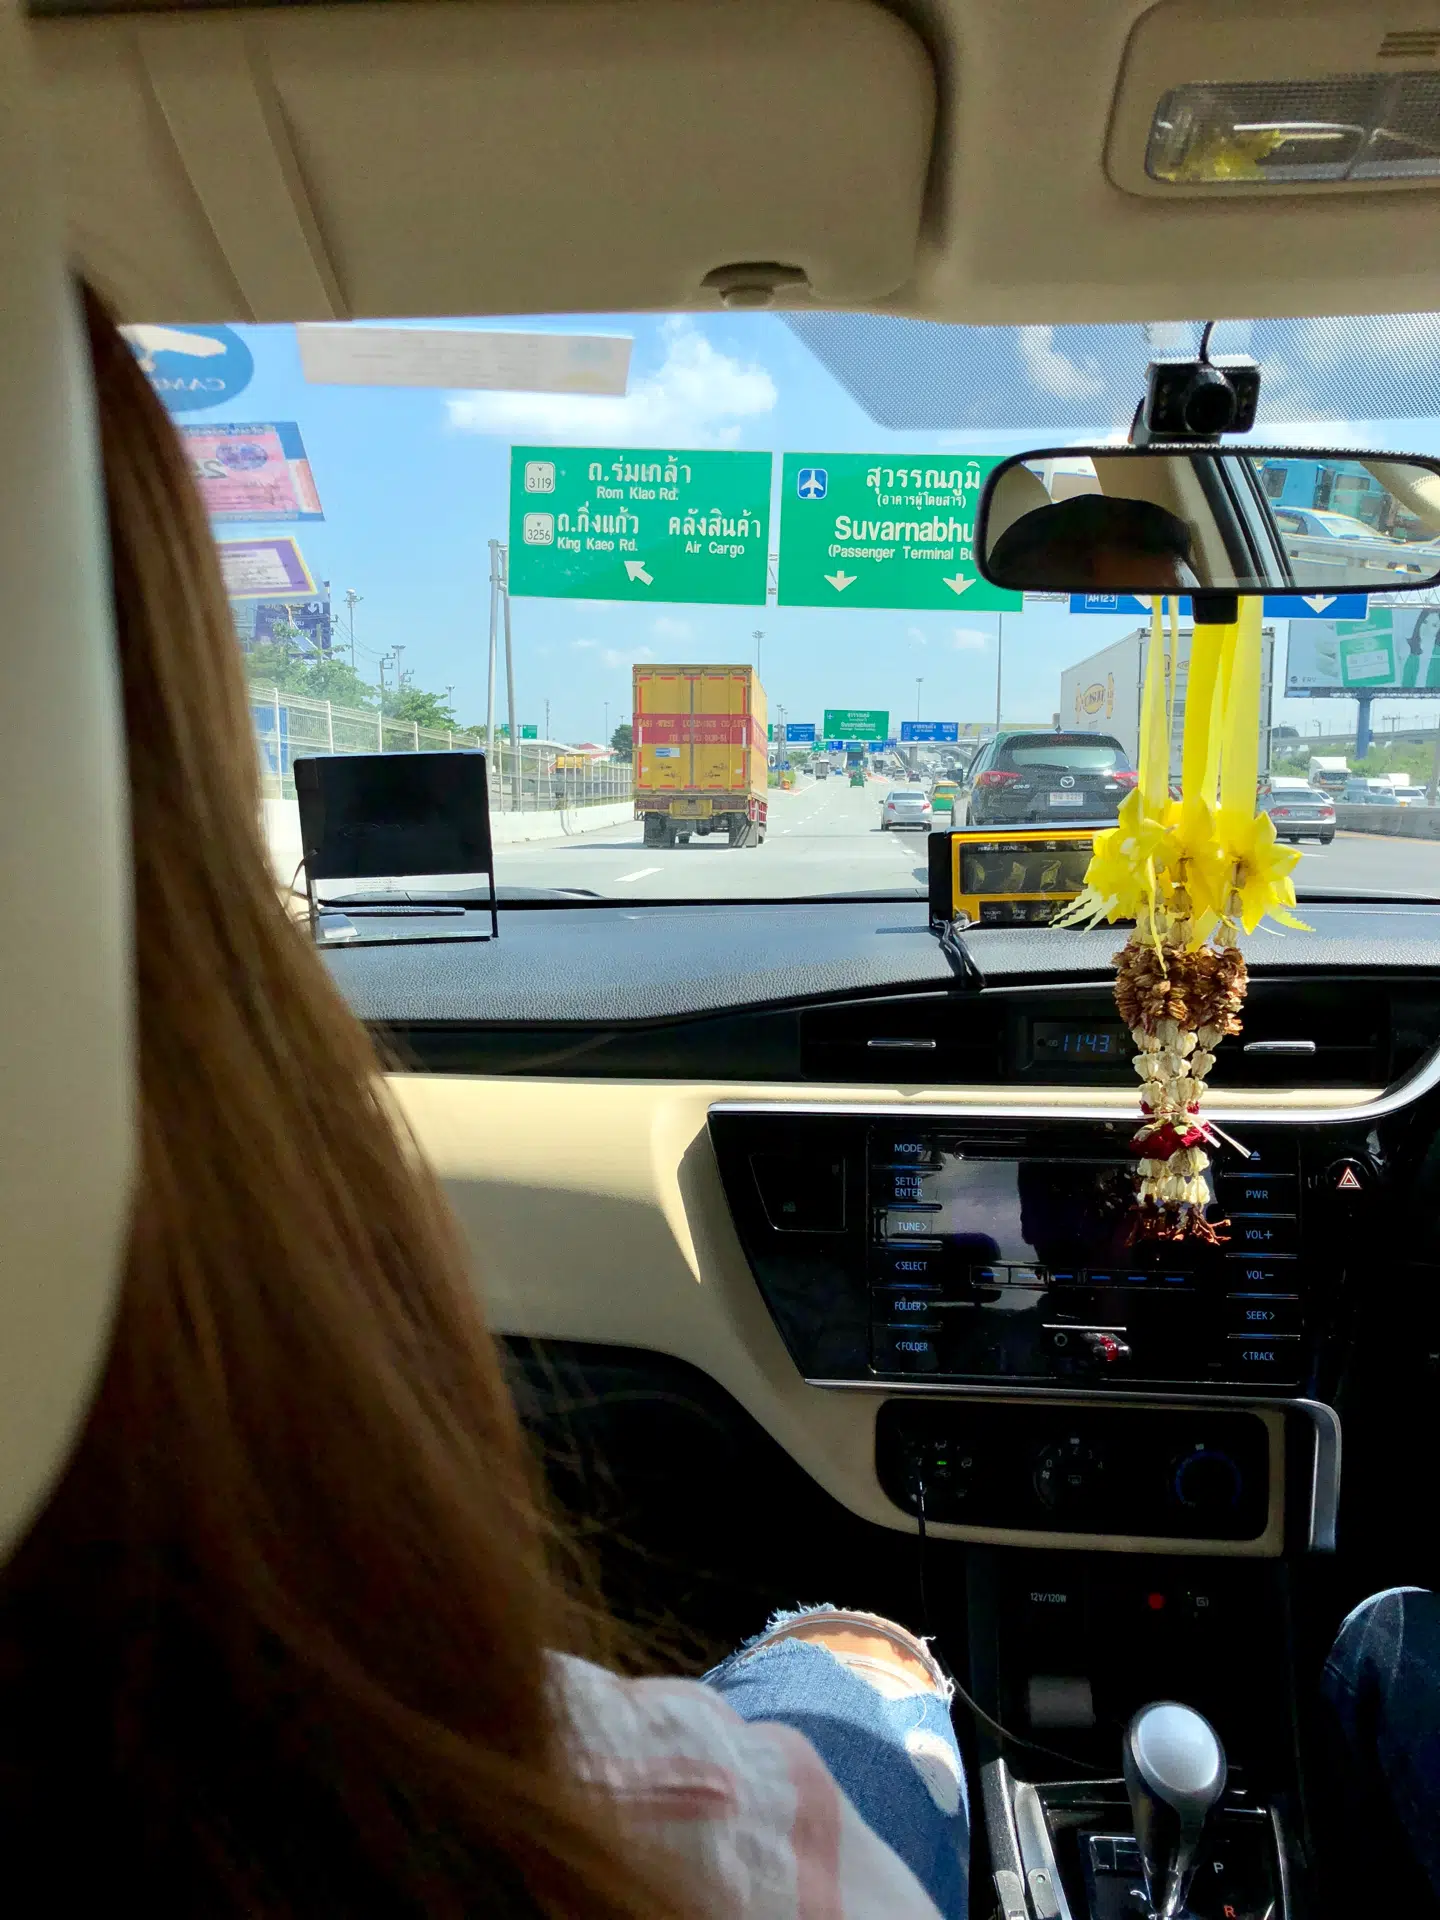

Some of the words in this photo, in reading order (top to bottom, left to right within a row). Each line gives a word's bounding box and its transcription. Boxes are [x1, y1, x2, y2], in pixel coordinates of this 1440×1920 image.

[588, 455, 692, 485] ถ.ร่มเกล้า
[528, 477, 552, 489] 3119
[866, 461, 980, 497] สุวรรณภูมิ
[596, 486, 624, 500] Rom
[629, 486, 656, 500] Klao
[659, 487, 679, 501] Rd.
[877, 492, 967, 511] (อาคารผู้โดยสาร)
[557, 501, 639, 534] ถ.กิ่งแก้ว
[669, 507, 761, 538] คลังสินค้า
[527, 529, 551, 541] 3256
[834, 515, 975, 542] Suvarnabhu
[557, 537, 581, 552] King
[586, 538, 615, 551] Kaeo
[619, 538, 638, 552] Rd.
[685, 541, 702, 554] Air
[708, 542, 745, 558] Cargo
[828, 543, 895, 562] (Passenger
[903, 545, 954, 561] Terminal
[894, 1143, 924, 1154] MODE
[895, 1177, 924, 1187] SETUP
[895, 1188, 924, 1197] ENTER
[1245, 1189, 1269, 1199] PWR
[1029, 1591, 1067, 1604] 12V/120W
[1213, 1862, 1224, 1874] P
[1223, 1904, 1236, 1918] R
